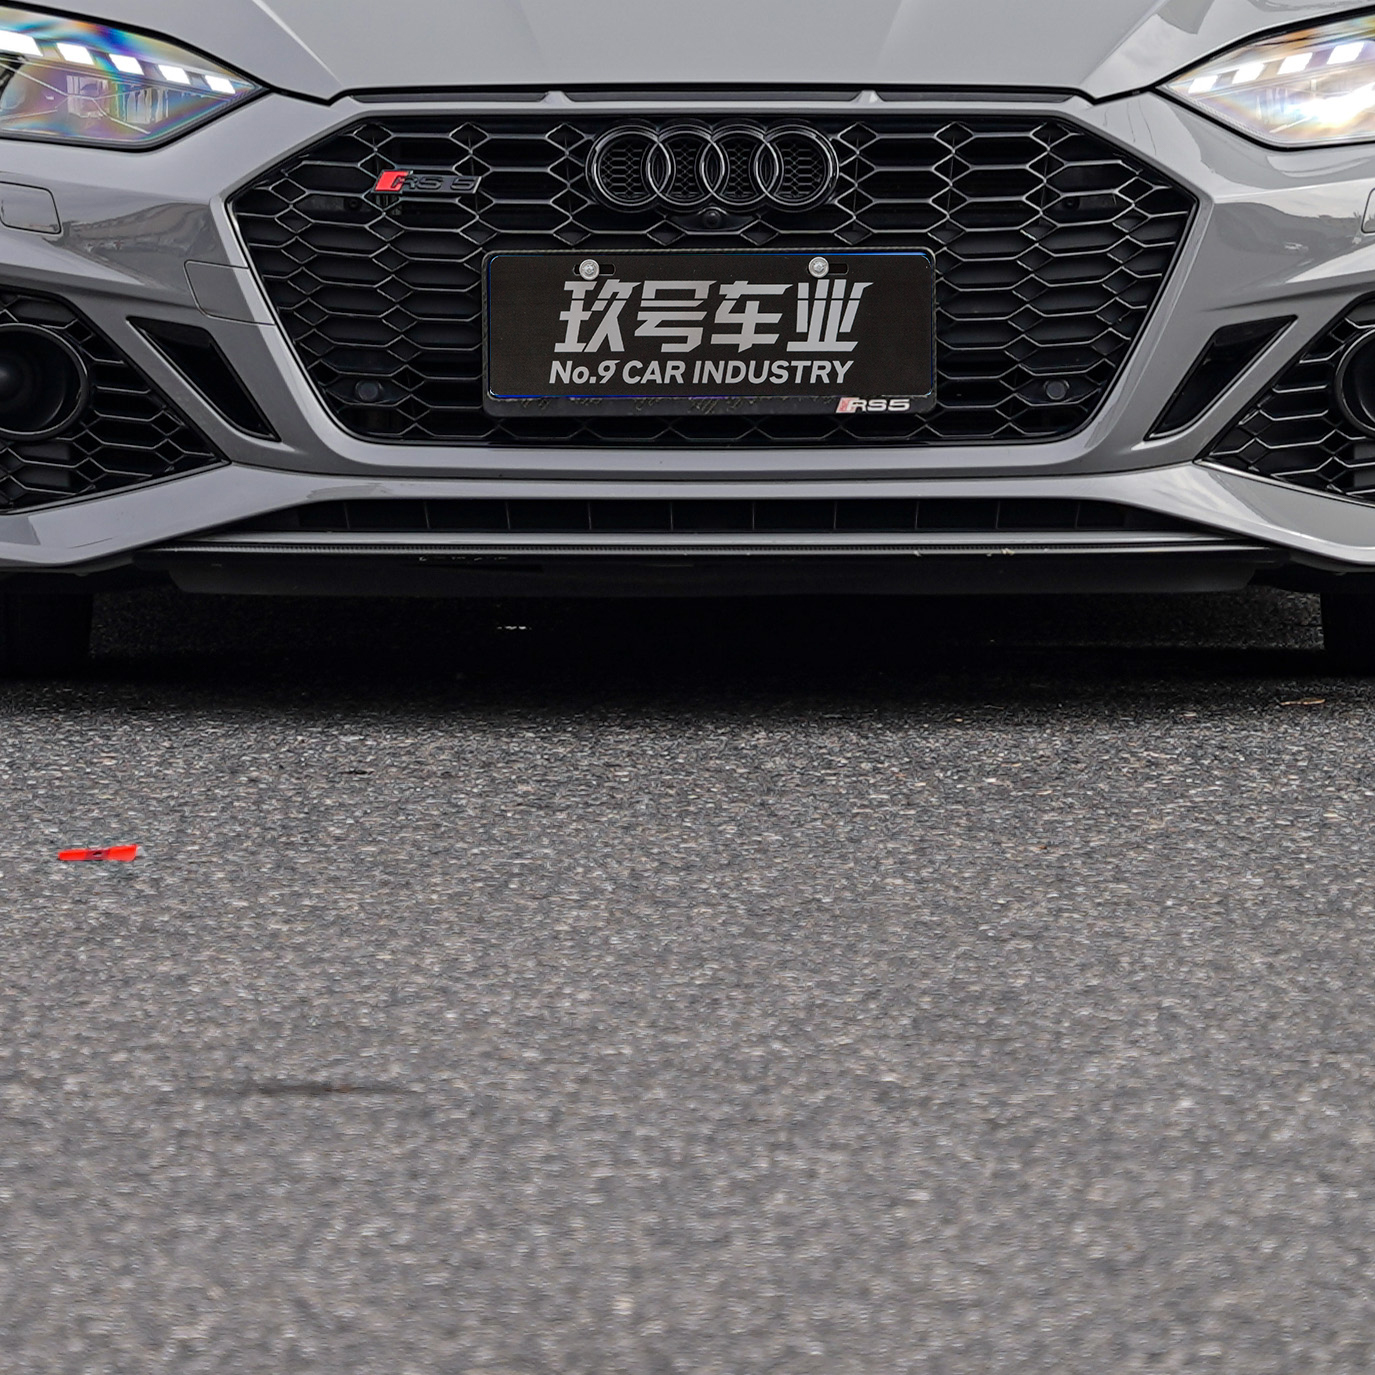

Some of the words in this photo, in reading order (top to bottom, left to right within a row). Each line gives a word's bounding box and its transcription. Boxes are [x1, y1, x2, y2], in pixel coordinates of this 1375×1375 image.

[553, 279, 874, 353] 玖号车业
[548, 359, 621, 385] No.9
[622, 360, 686, 385] CAR
[692, 360, 855, 385] INDUSTRY
